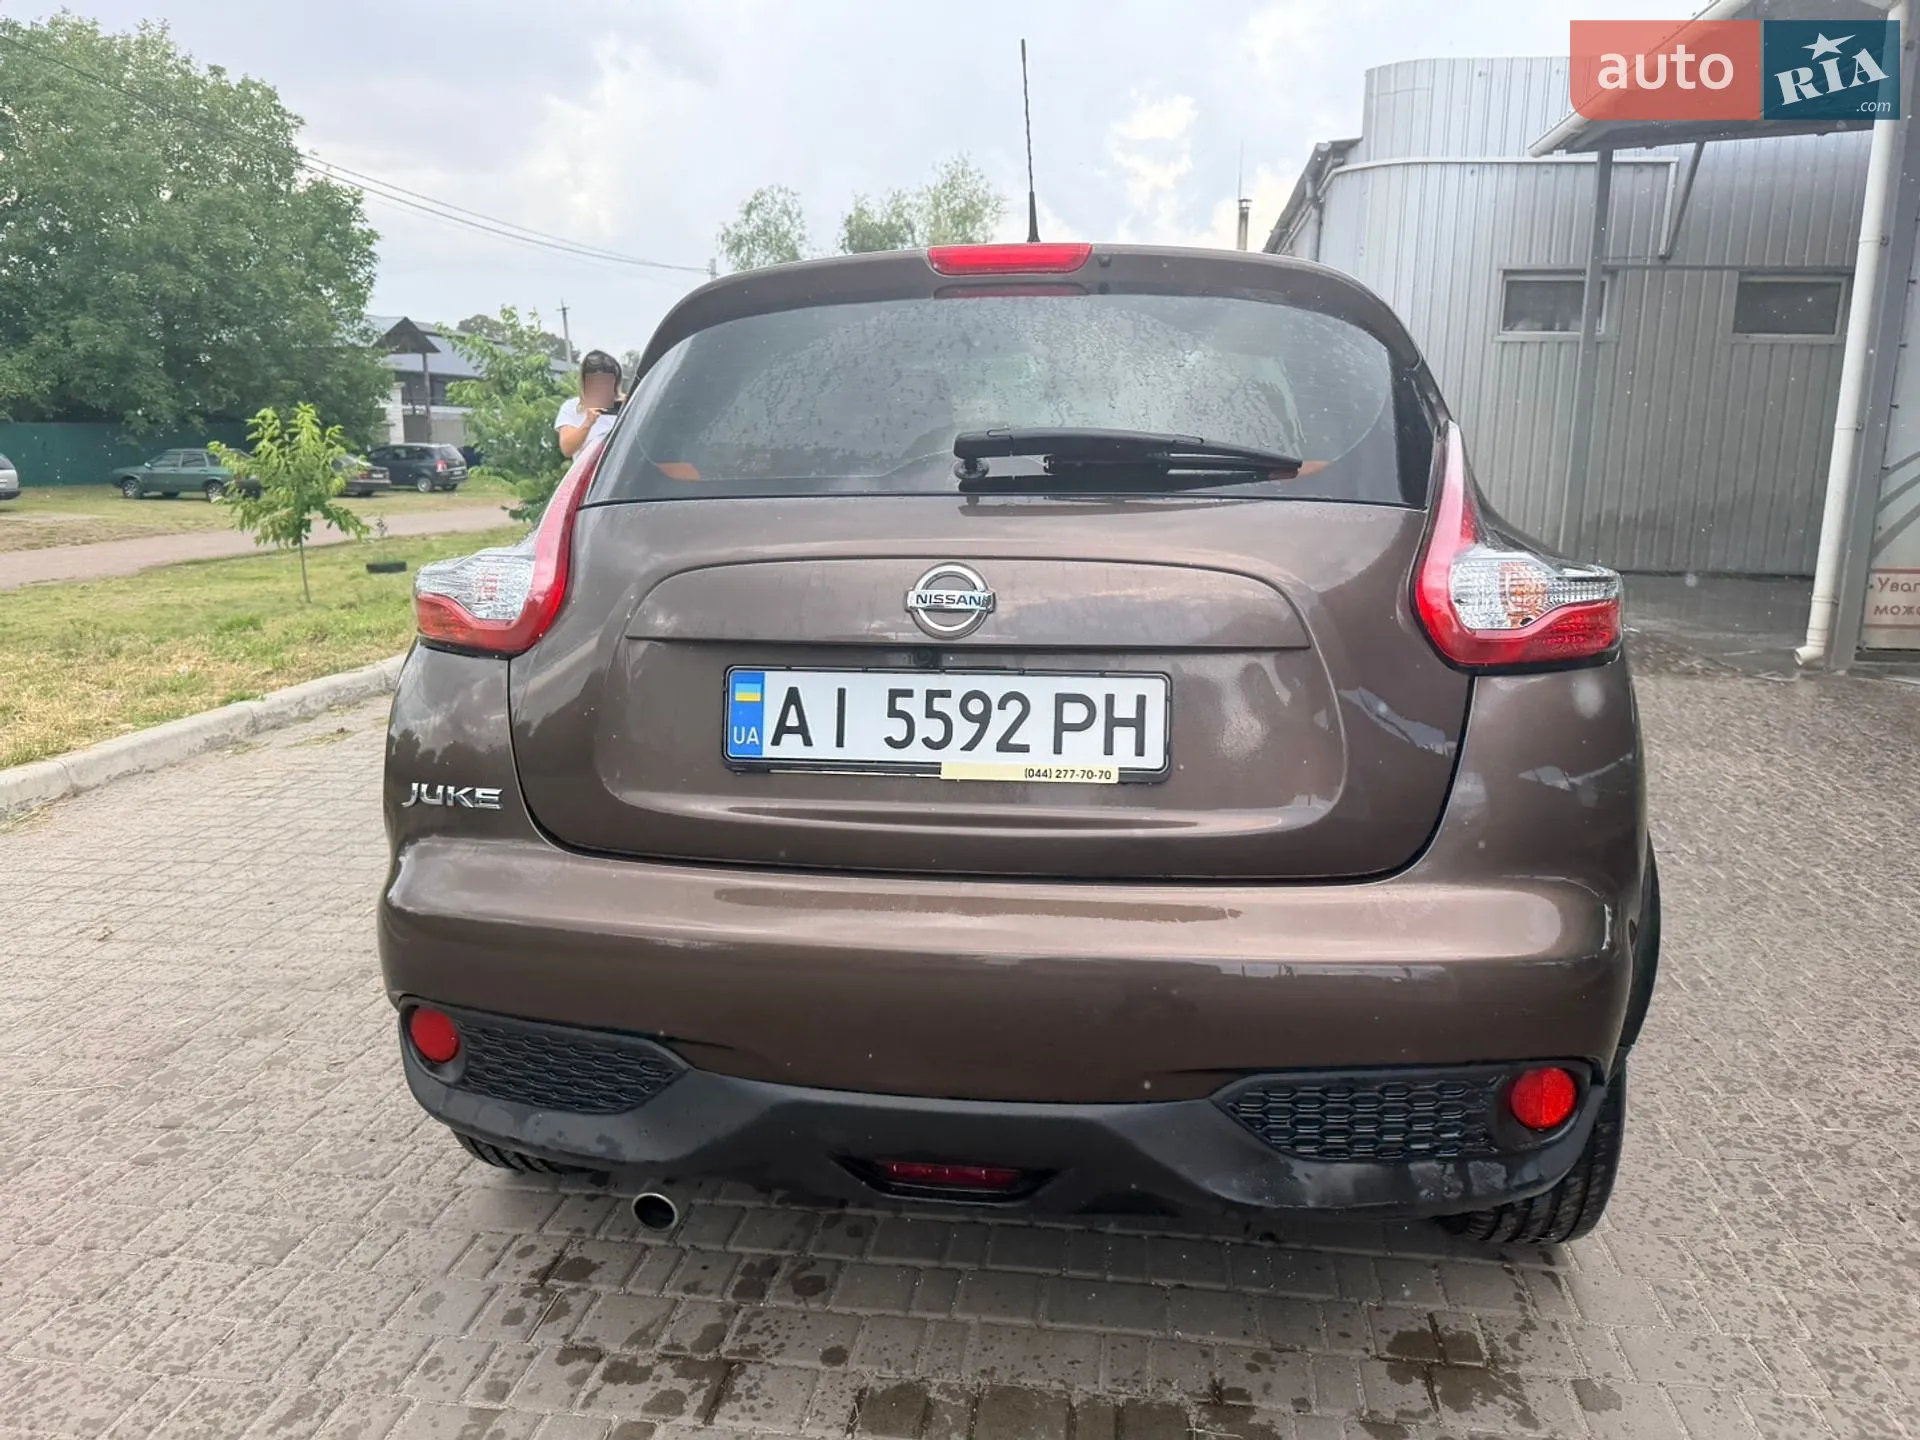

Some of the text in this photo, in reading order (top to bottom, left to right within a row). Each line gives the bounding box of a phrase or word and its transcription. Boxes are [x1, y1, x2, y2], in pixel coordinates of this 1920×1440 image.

[916, 594, 981, 606] NISSAN
[883, 688, 1031, 754] 5592
[1053, 692, 1147, 756] PH
[733, 726, 759, 745] UA
[1024, 767, 1112, 780] (044) 277-70-70
[400, 782, 503, 809] JUKE
